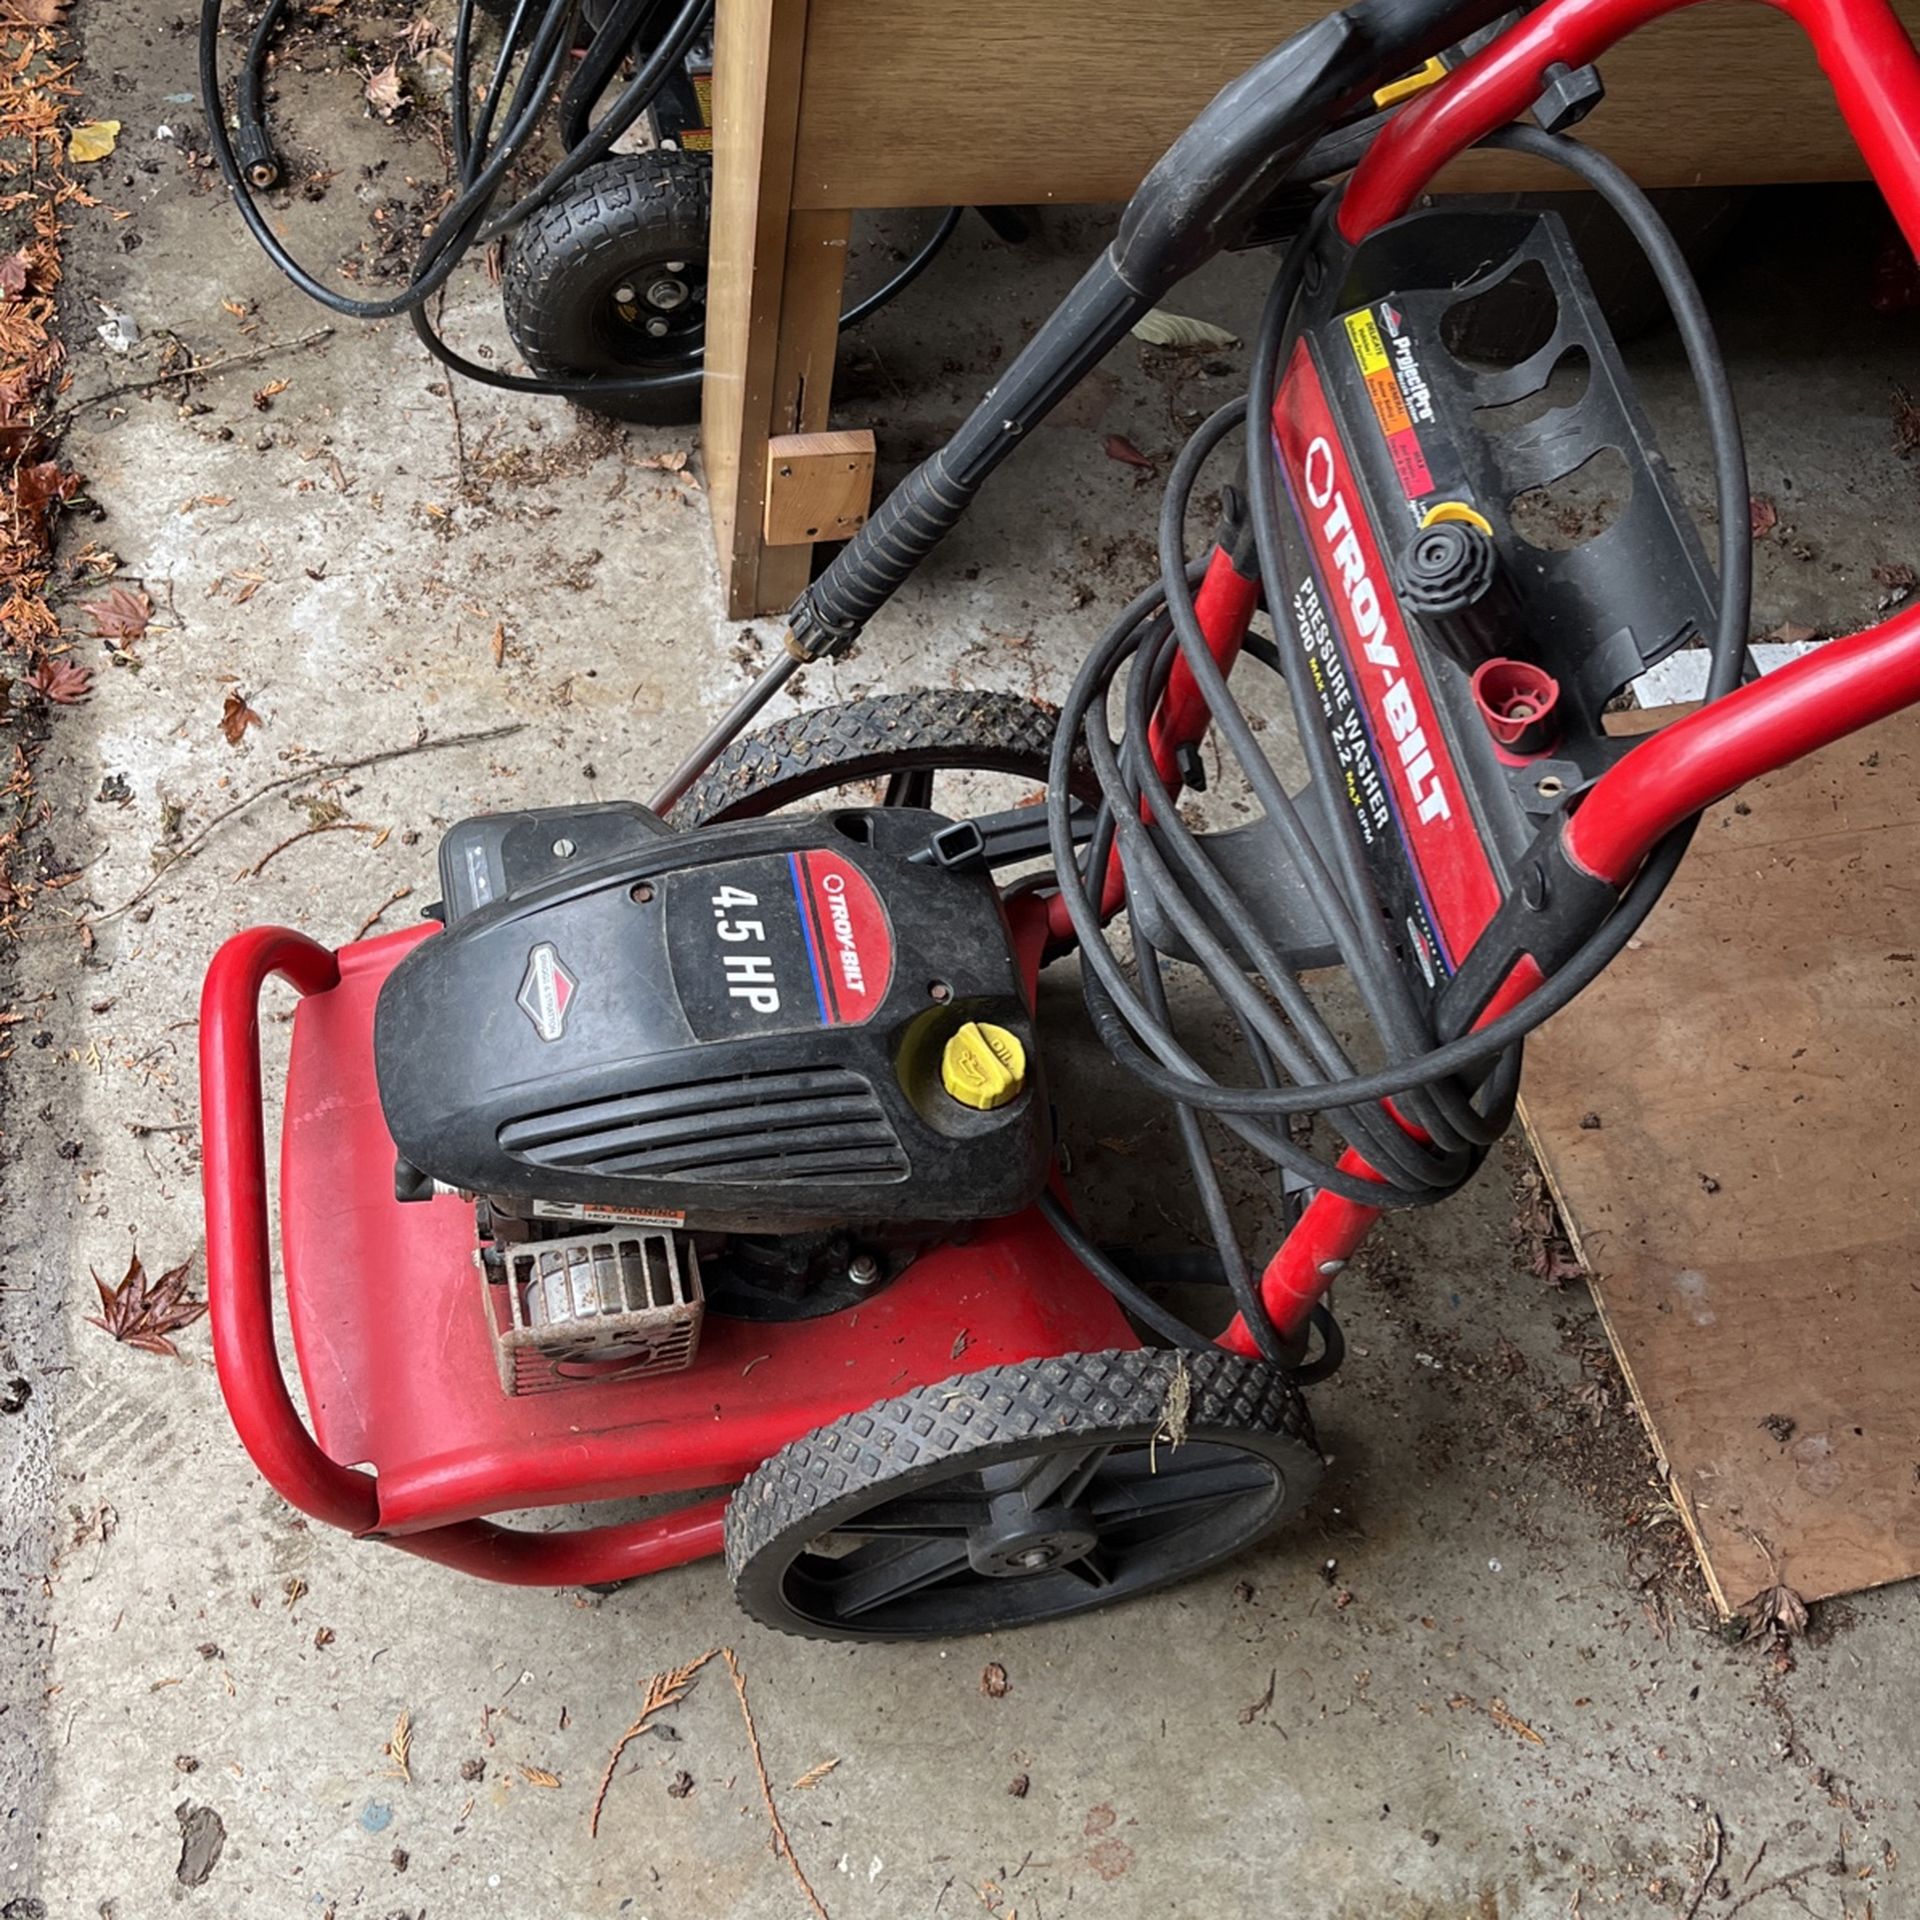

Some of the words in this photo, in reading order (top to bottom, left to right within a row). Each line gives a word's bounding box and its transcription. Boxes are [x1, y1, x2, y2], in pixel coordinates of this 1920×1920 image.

[1299, 575, 1351, 711] PRESSURE
[1344, 707, 1390, 830] WASHER
[1309, 657, 1326, 693] MAX
[1320, 692, 1333, 719] PSI
[1332, 724, 1352, 767] 2.2
[1345, 770, 1363, 809] MAX
[1357, 807, 1374, 845] GPM
[710, 885, 767, 943] 4.5
[723, 956, 782, 1014] HP
[543, 992, 558, 1034] STRATTON
[990, 1039, 1013, 1068] OIL
[611, 1206, 678, 1217] WARNING
[616, 1216, 679, 1225] SURFACES
